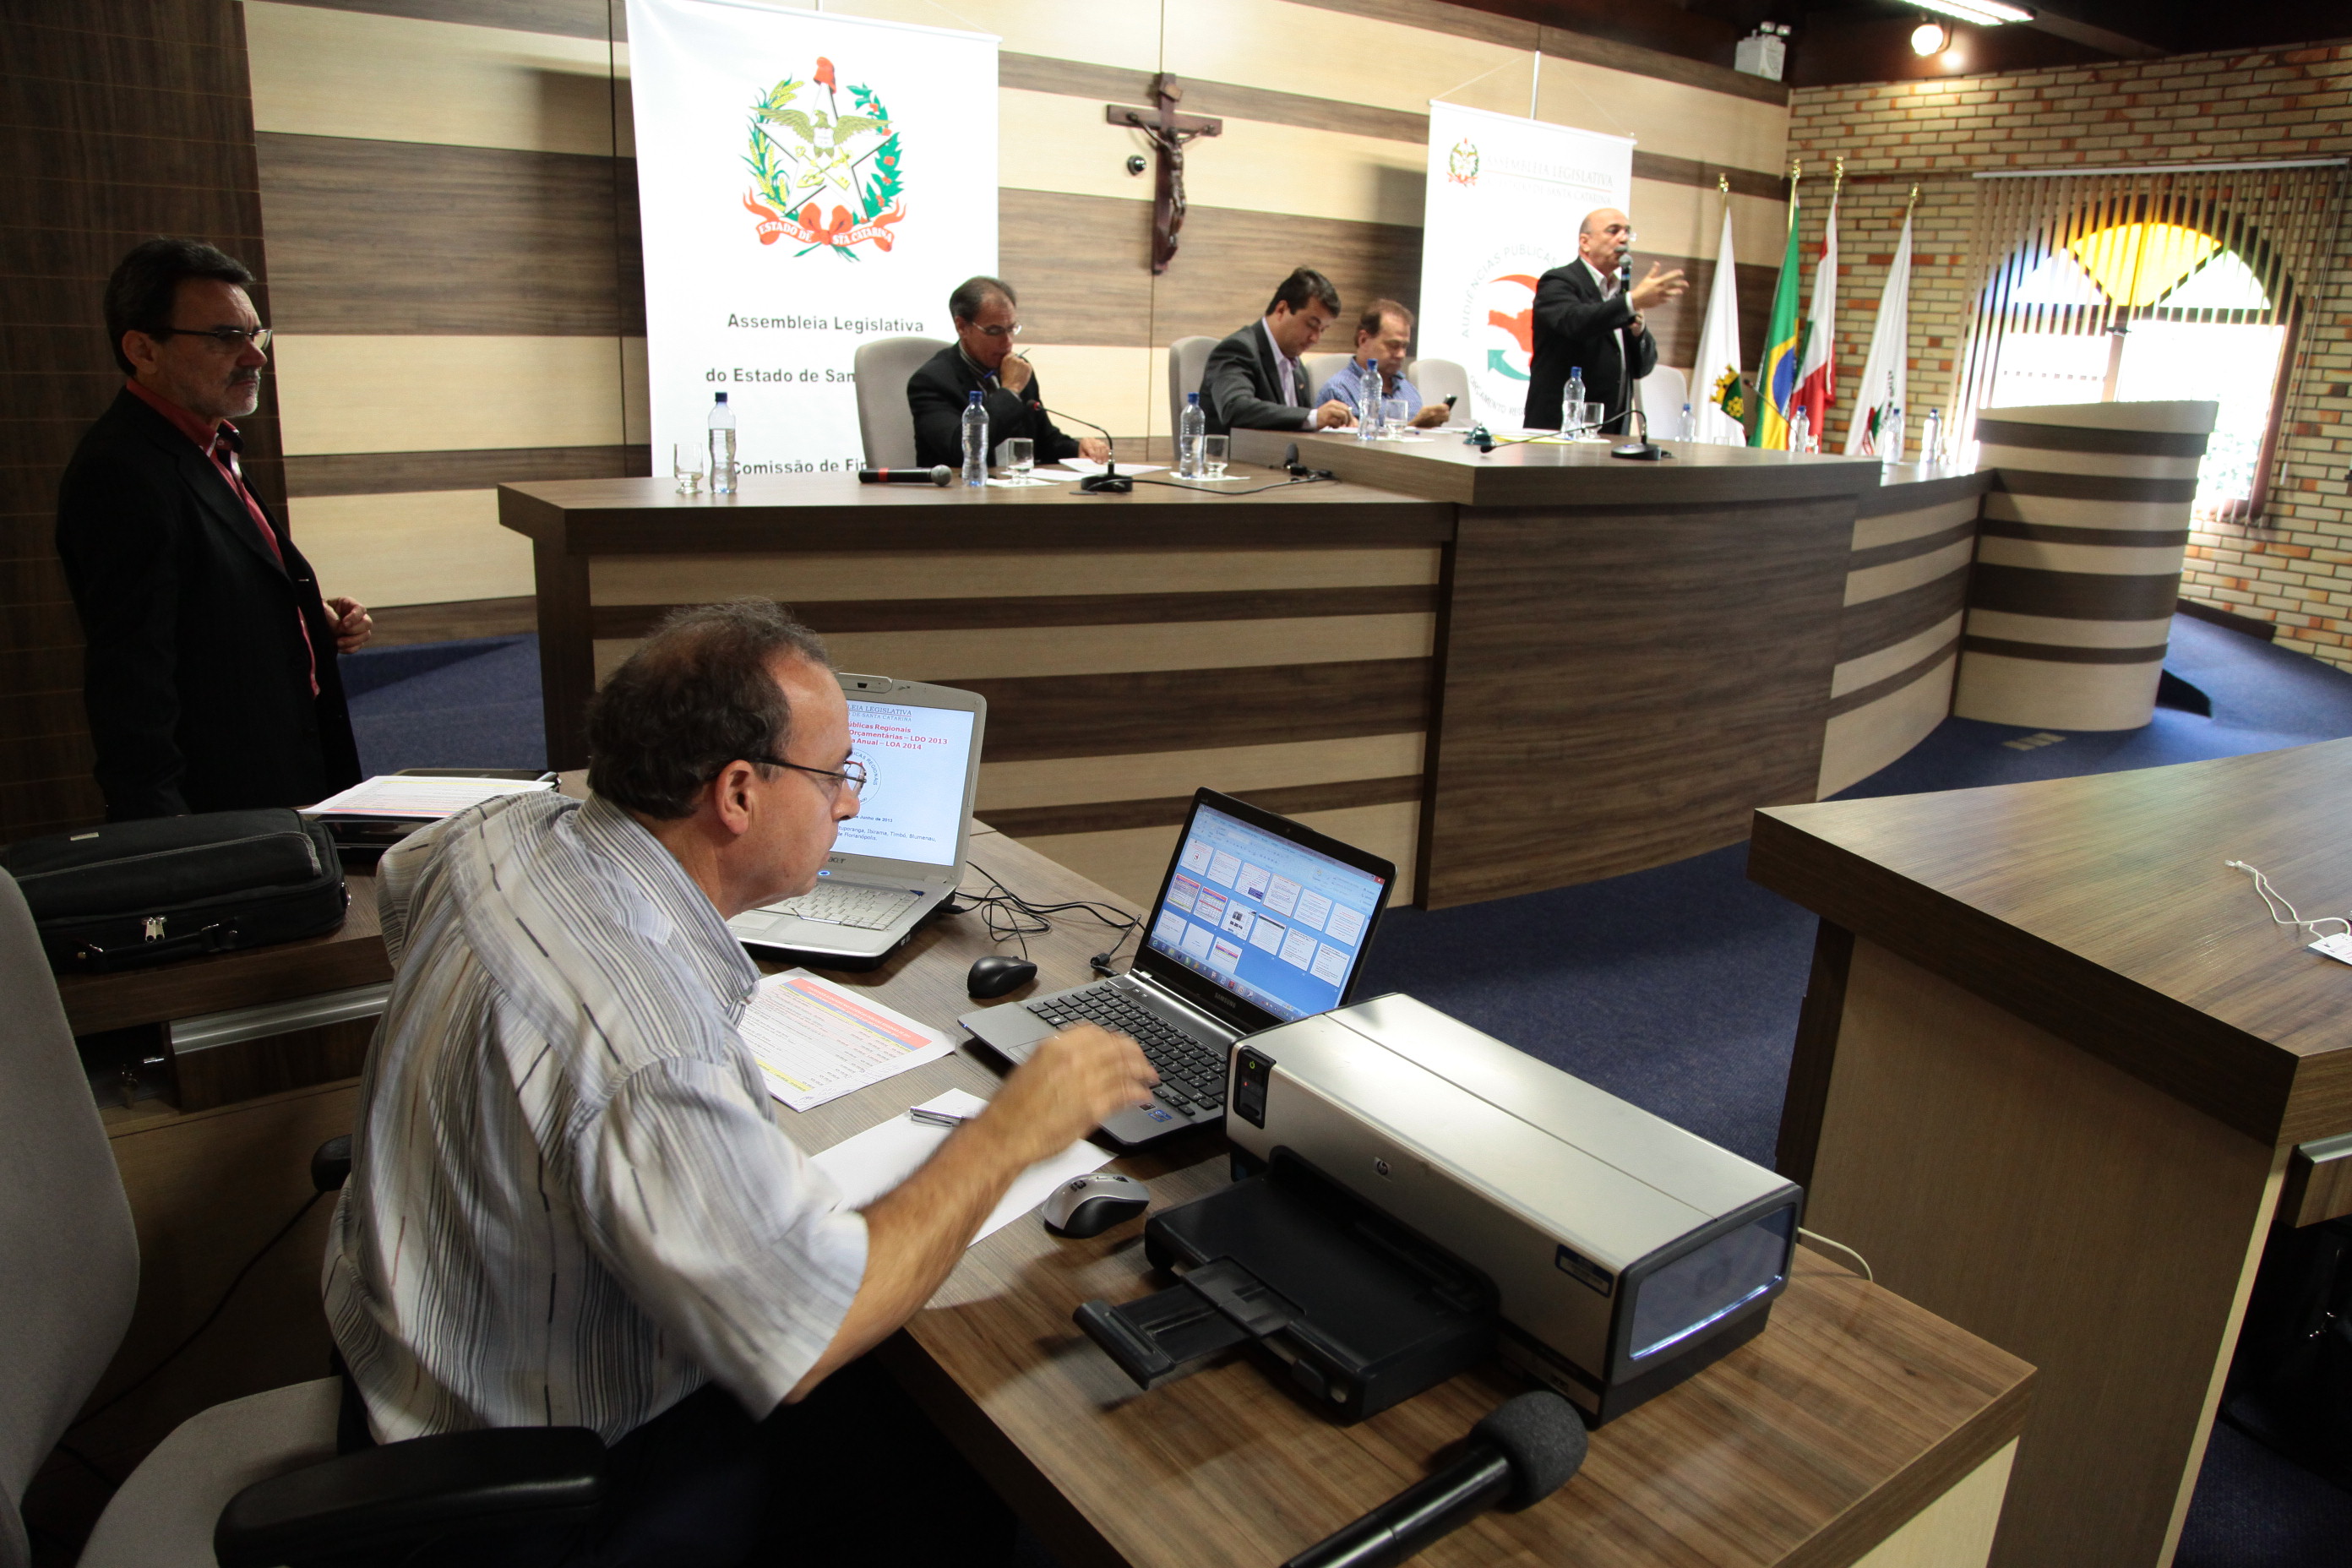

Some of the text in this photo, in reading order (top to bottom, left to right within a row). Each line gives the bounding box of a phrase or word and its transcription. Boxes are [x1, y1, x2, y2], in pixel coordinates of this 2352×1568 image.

[759, 220, 798, 237] ESTADO
[727, 313, 923, 335] Assembleia Legislativa
[705, 368, 856, 383] do Estado de San
[734, 460, 813, 475] Comissão
[819, 459, 839, 472] de
[865, 705, 912, 716] LEGISLATIVA
[848, 721, 912, 733] úblicas Regionais
